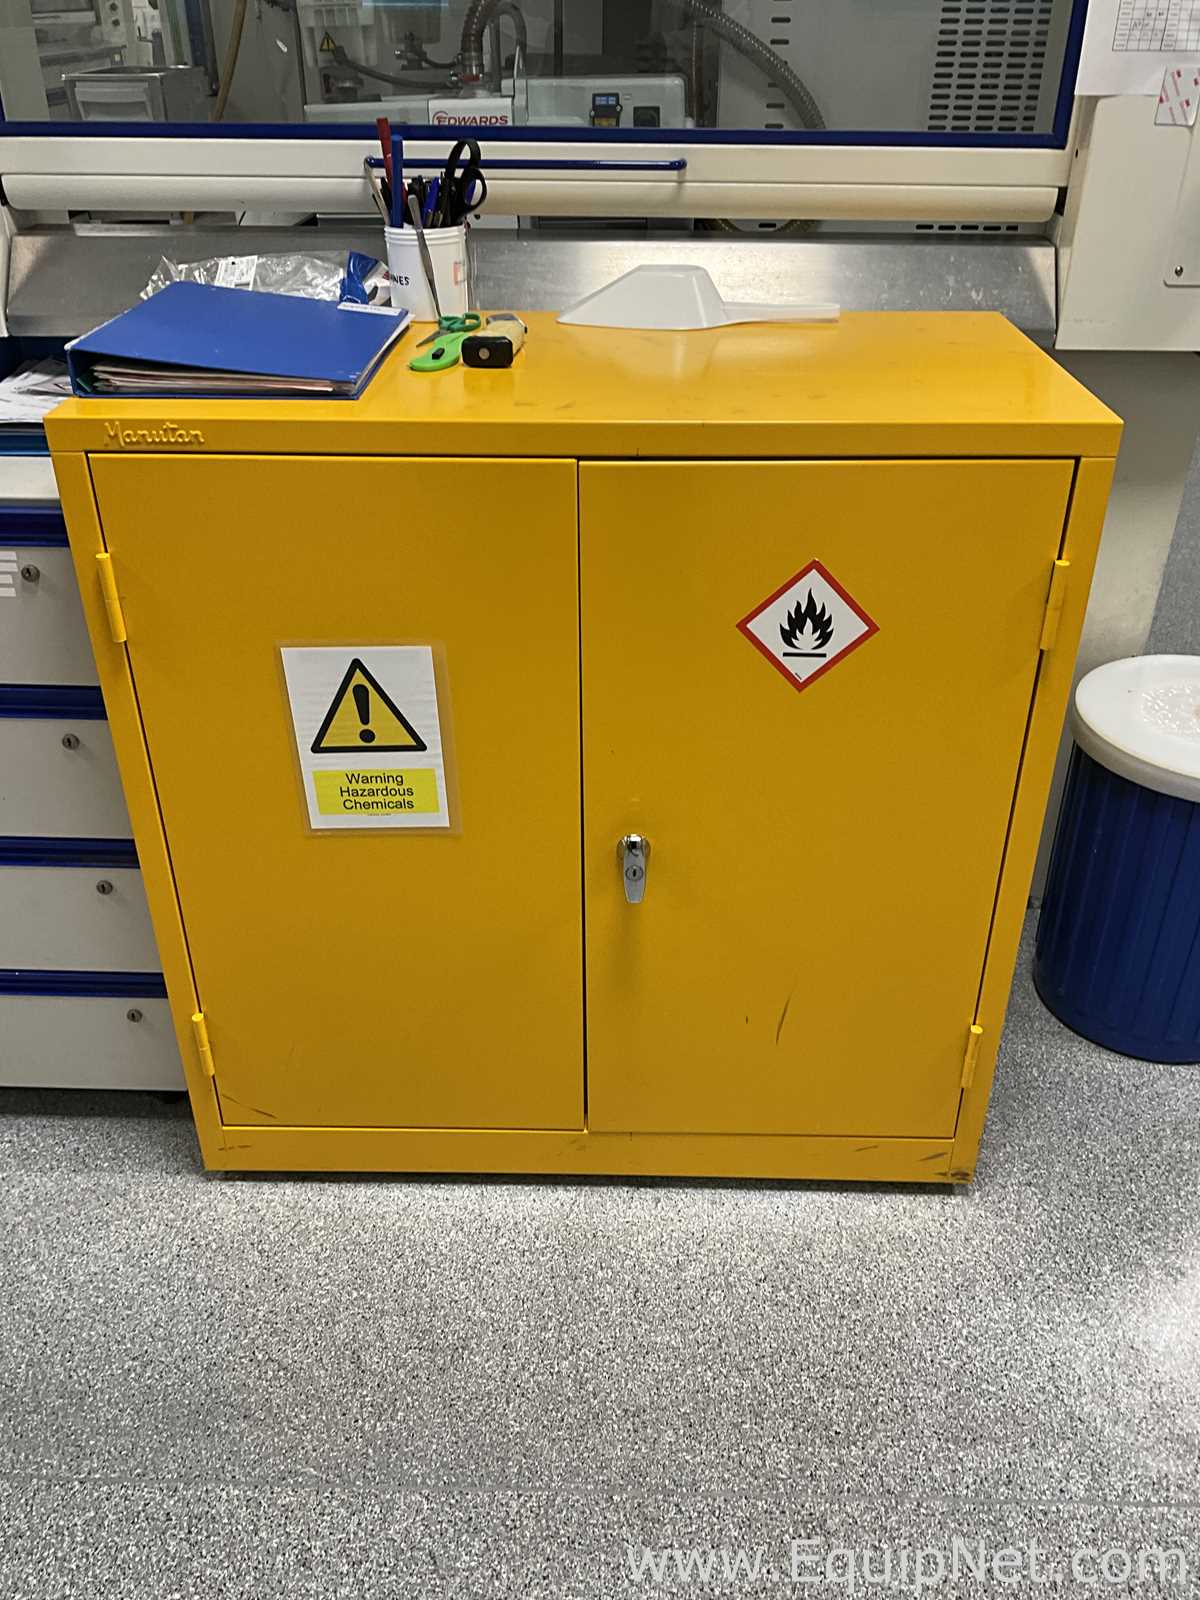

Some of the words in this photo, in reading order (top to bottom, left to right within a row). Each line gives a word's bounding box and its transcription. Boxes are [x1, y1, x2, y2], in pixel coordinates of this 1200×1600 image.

[432, 112, 508, 126] EDWARDS
[104, 421, 205, 446] Manutan
[346, 773, 404, 786] Warning
[340, 786, 414, 798] Hazardous
[343, 798, 414, 810] Chemicals
